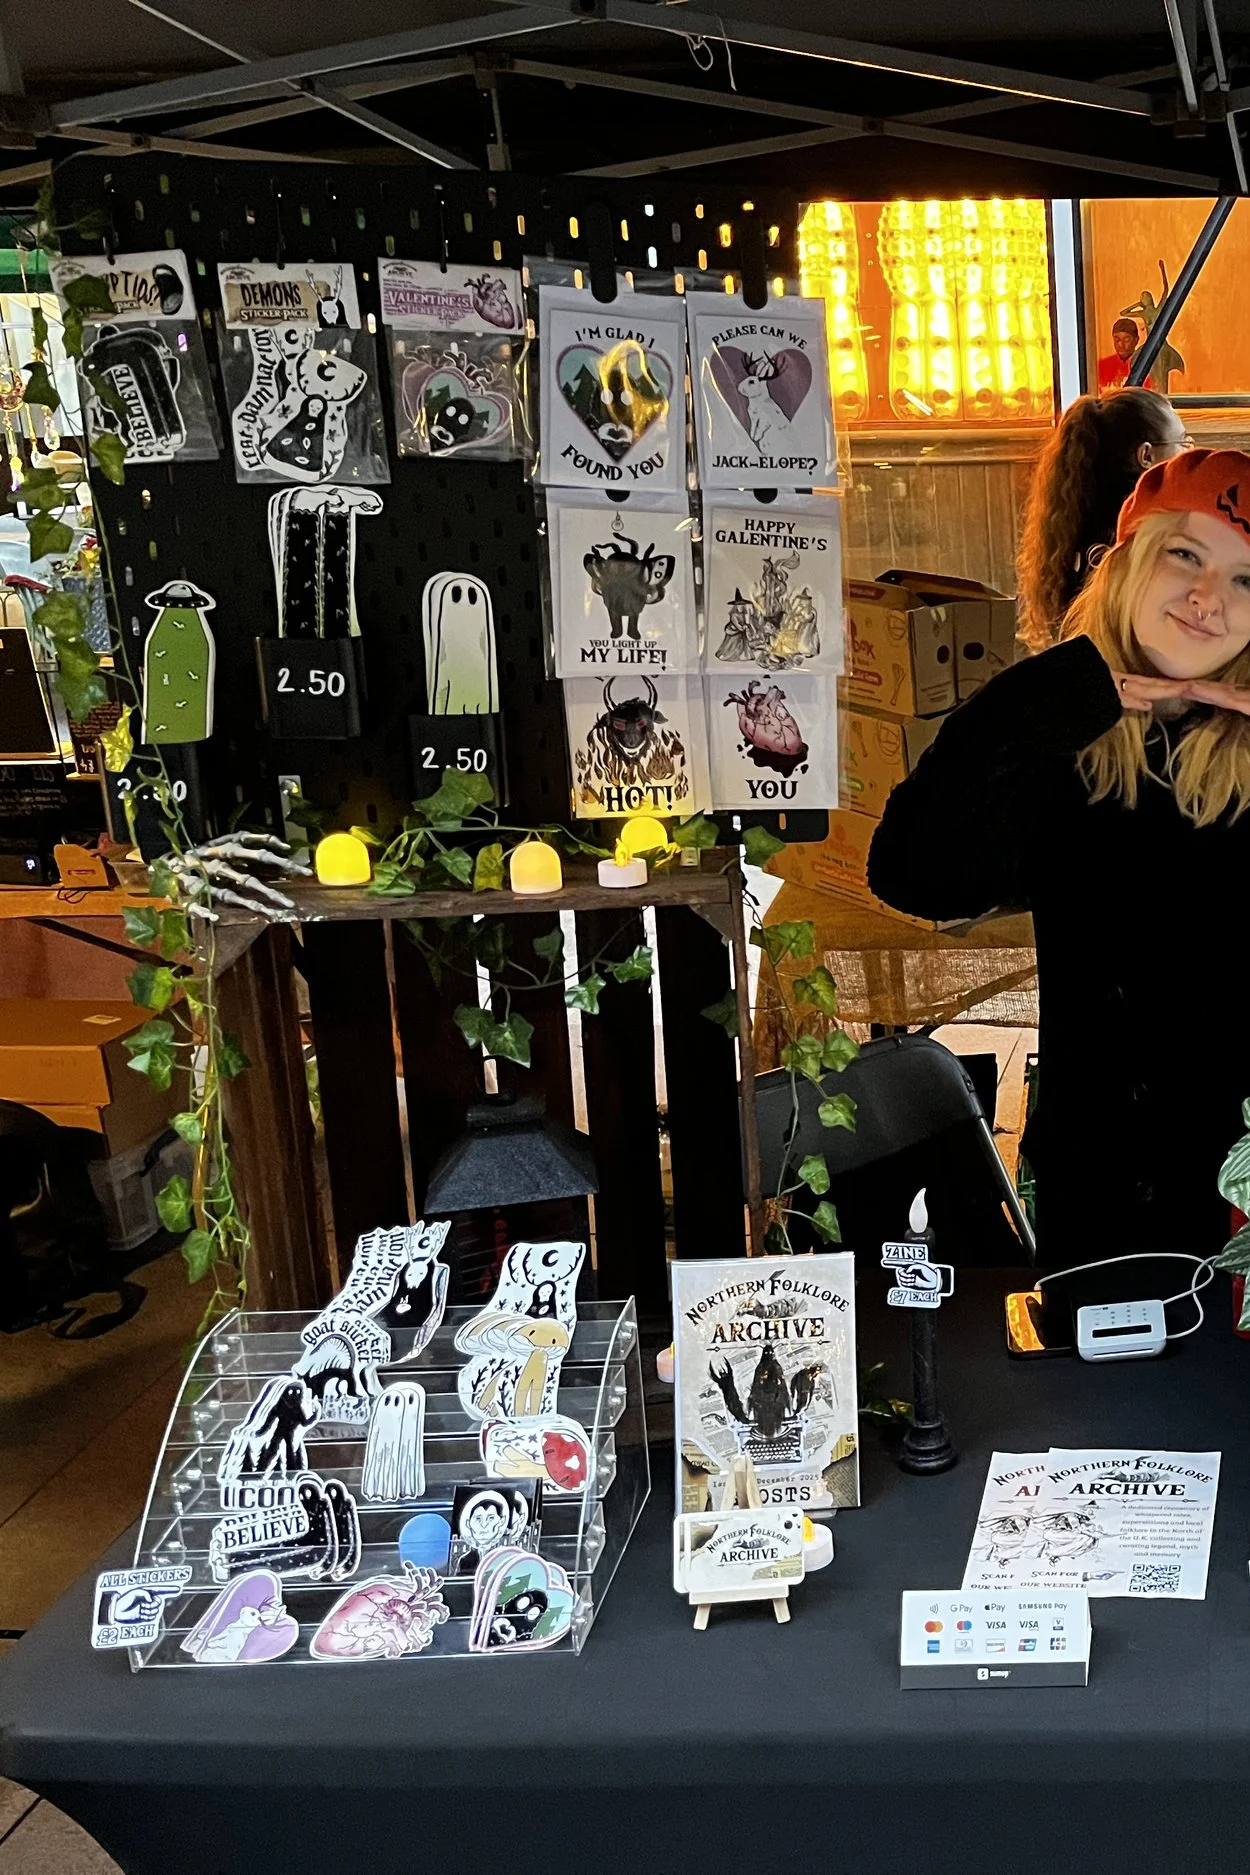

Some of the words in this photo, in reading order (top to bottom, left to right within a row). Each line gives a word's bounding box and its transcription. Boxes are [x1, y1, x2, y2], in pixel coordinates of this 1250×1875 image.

[240, 281, 301, 308] DEMONS
[388, 291, 469, 307] VALENTINE'S
[575, 327, 601, 342] I'M
[605, 327, 645, 344] GLAD
[648, 338, 655, 349] I
[712, 325, 757, 346] PLEASE
[759, 325, 785, 338] CAN
[788, 332, 808, 350] WE
[560, 444, 623, 480] FOUND
[629, 452, 665, 480] YOU
[712, 455, 819, 476] JACK-ELOPE?
[744, 518, 796, 534] HAPPY
[715, 530, 828, 551] GALENTINE'S
[589, 639, 609, 648] YOU
[612, 640, 642, 649] LIGHT
[644, 641, 657, 649] UP
[580, 648, 614, 663] MY
[617, 649, 667, 671] LIFE!
[277, 668, 346, 697] 2.50
[421, 747, 488, 772] 2.50
[605, 785, 674, 813] HOT!
[745, 780, 798, 799] YOU
[885, 1244, 926, 1260] ZINE
[684, 1280, 766, 1327] NORTHERN
[770, 1278, 850, 1312] FOLKLORE
[910, 1291, 938, 1302] EACH
[711, 1317, 825, 1343] ARCHIVE
[756, 1476, 795, 1485] December
[1047, 1459, 1130, 1484] NORTHERN
[1134, 1457, 1213, 1484] FOLKLORE
[1069, 1483, 1186, 1497] ARCHIVE
[223, 1515, 306, 1548] BELIEVE
[705, 1528, 749, 1553] NORTHERN
[749, 1524, 792, 1546] FOLKLORE
[720, 1548, 779, 1562] ARCHIVE
[100, 1573, 127, 1588] ALL
[126, 1567, 191, 1586] STICKERS
[959, 1604, 973, 1614] Pay
[991, 1603, 1006, 1613] Pay
[1054, 1602, 1068, 1611] Pay
[985, 1621, 1007, 1629] VISA
[1019, 1620, 1039, 1628] VISA
[96, 1627, 118, 1646] £2
[120, 1624, 154, 1640] EACH
